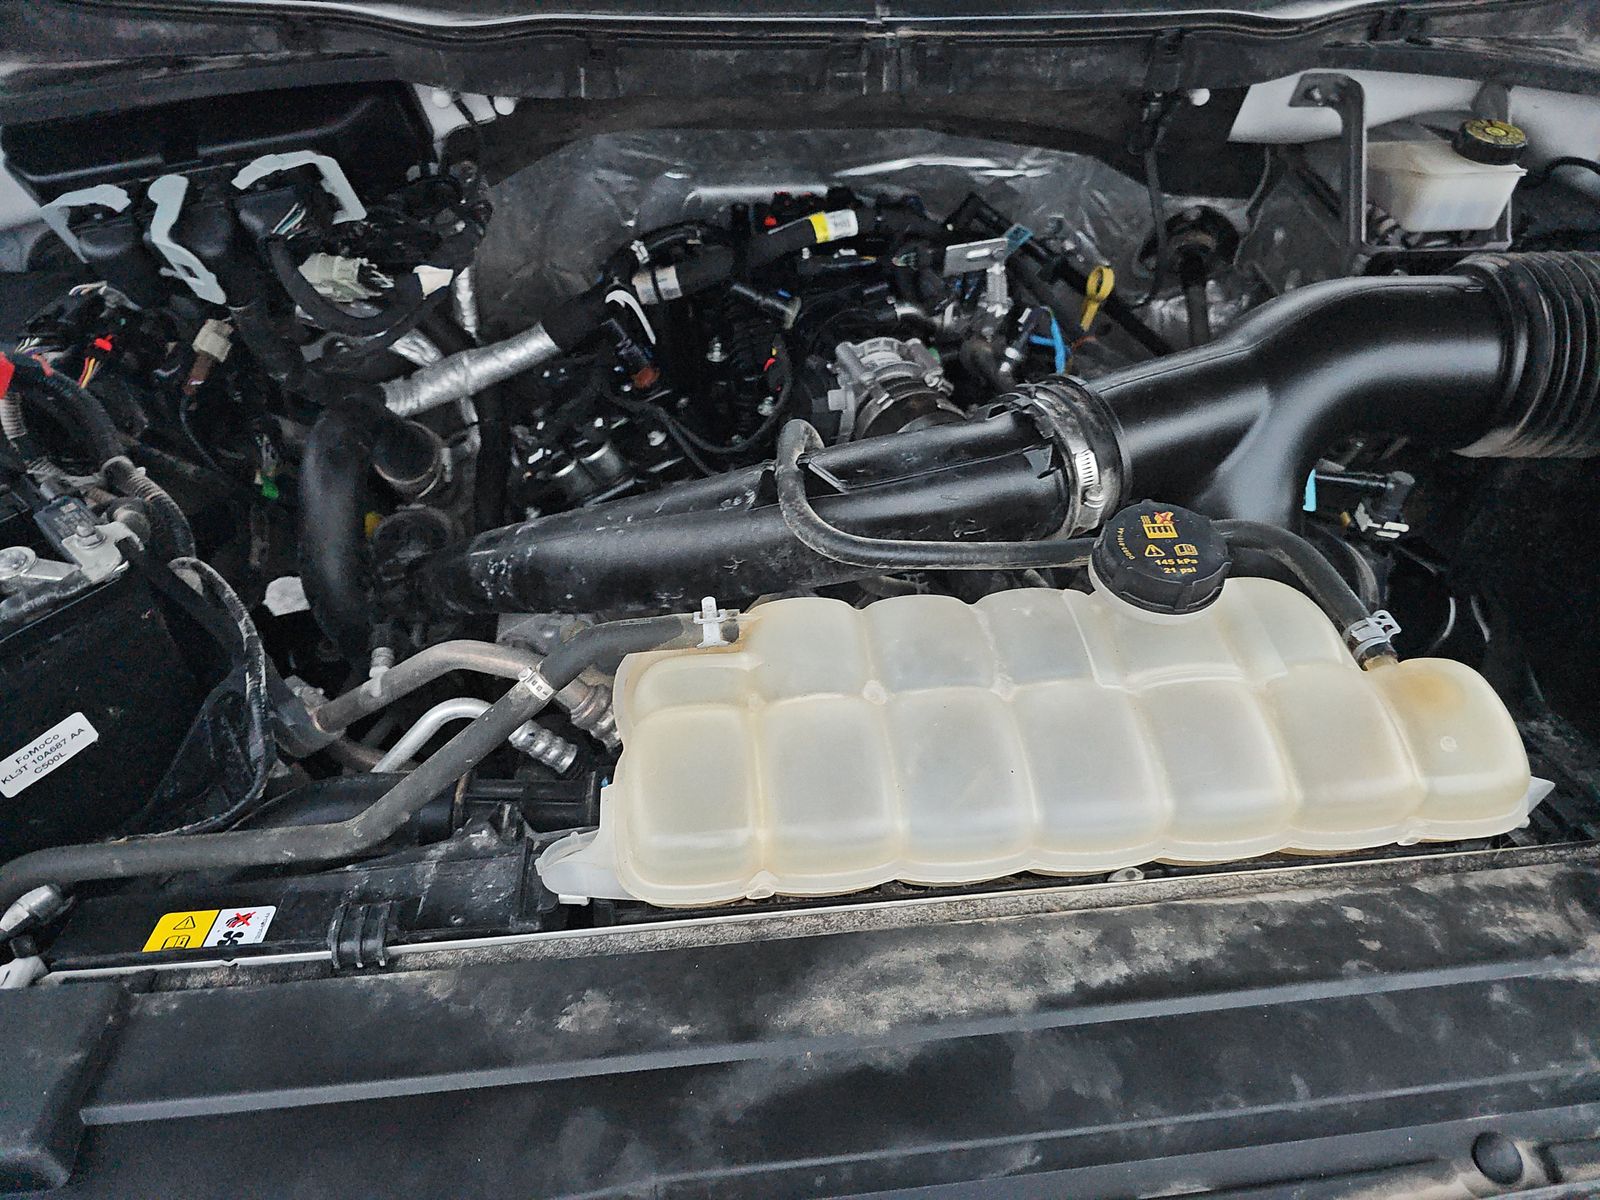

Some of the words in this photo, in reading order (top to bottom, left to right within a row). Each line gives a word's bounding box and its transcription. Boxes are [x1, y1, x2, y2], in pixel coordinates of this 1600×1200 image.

[1180, 566, 1197, 575] psi
[1, 763, 29, 785] KL3T
[32, 738, 68, 765] 10A687
[70, 727, 85, 740] AA
[15, 733, 60, 765] FoMoCo
[34, 752, 67, 775] C500L
